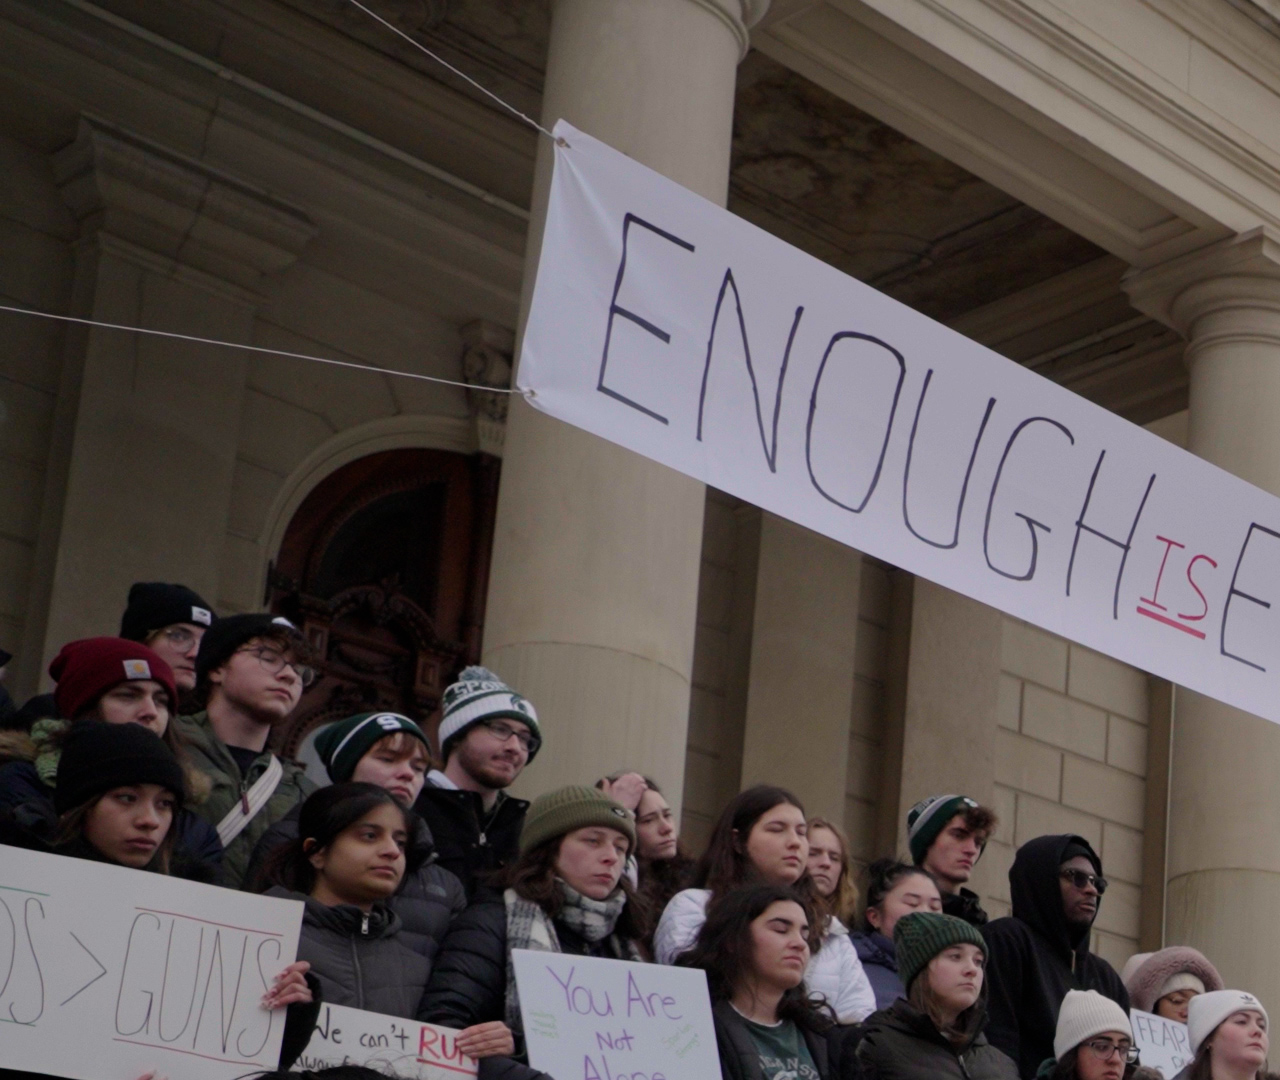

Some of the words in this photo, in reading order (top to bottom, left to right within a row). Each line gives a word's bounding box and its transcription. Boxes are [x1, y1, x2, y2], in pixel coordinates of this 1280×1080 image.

[597, 212, 1156, 621] ENOUGH
[1138, 535, 1218, 622] IS
[115, 912, 281, 1058] GUNS
[546, 965, 614, 1017] You
[627, 970, 683, 1020] Are
[359, 1023, 410, 1050] can't
[596, 1029, 634, 1051] Not
